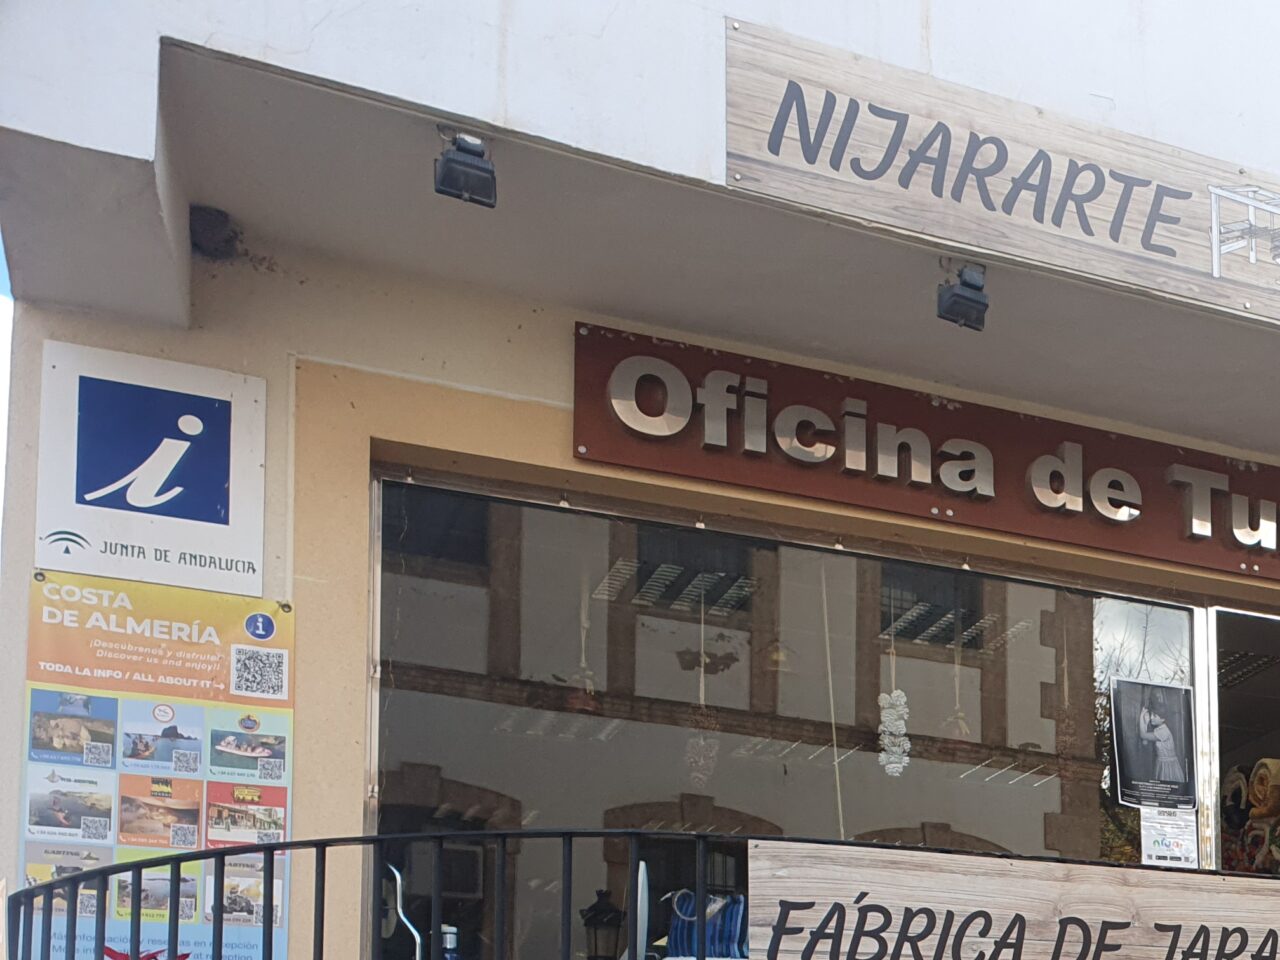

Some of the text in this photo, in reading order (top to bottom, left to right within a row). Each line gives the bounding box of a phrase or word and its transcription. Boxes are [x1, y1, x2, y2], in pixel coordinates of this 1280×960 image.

[767, 79, 1193, 257] NIJARARTE
[608, 355, 996, 499] Oficina
[1025, 441, 1143, 523] de
[100, 541, 257, 574] JUNTA DE ANDALUCIA
[42, 582, 133, 610] COSTA
[42, 606, 221, 645] DE ALMERÍA
[38, 661, 72, 674] TODA
[75, 667, 91, 676] LA
[94, 669, 123, 680] INFO
[132, 673, 154, 682] ALL
[157, 676, 200, 688] ABOUT
[96, 649, 144, 662] Discover
[162, 659, 182, 667] and
